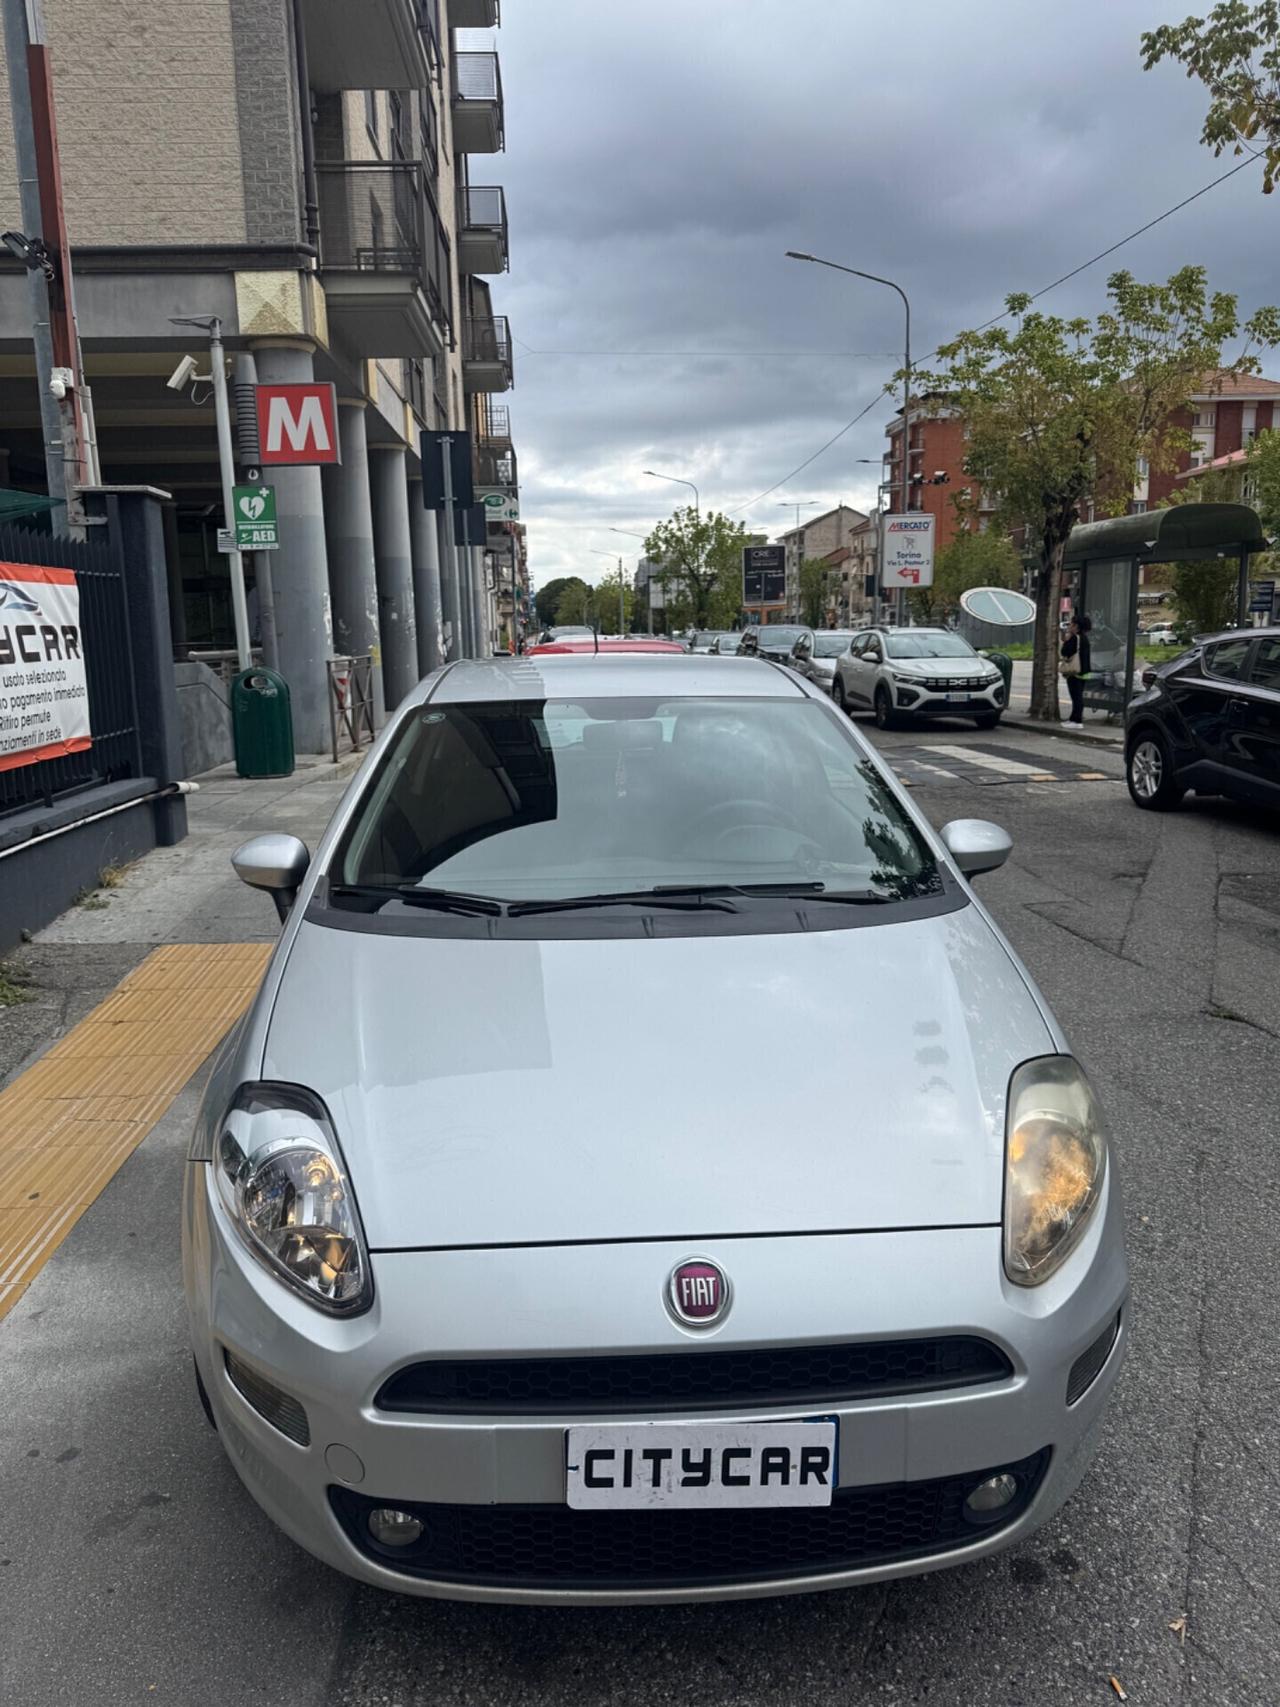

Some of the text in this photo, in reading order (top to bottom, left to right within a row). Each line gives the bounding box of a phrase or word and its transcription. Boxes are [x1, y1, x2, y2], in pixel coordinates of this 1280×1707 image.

[266, 396, 331, 452] M
[252, 530, 276, 542] AED
[888, 521, 930, 532] MERCATO
[3, 668, 66, 688] usato selezionato
[11, 691, 52, 711] pagamento
[53, 685, 86, 699] immediato
[21, 711, 51, 730] permute
[45, 727, 62, 742] sede
[681, 1276, 716, 1307] FIAT
[584, 1446, 830, 1488] CITYCAR
